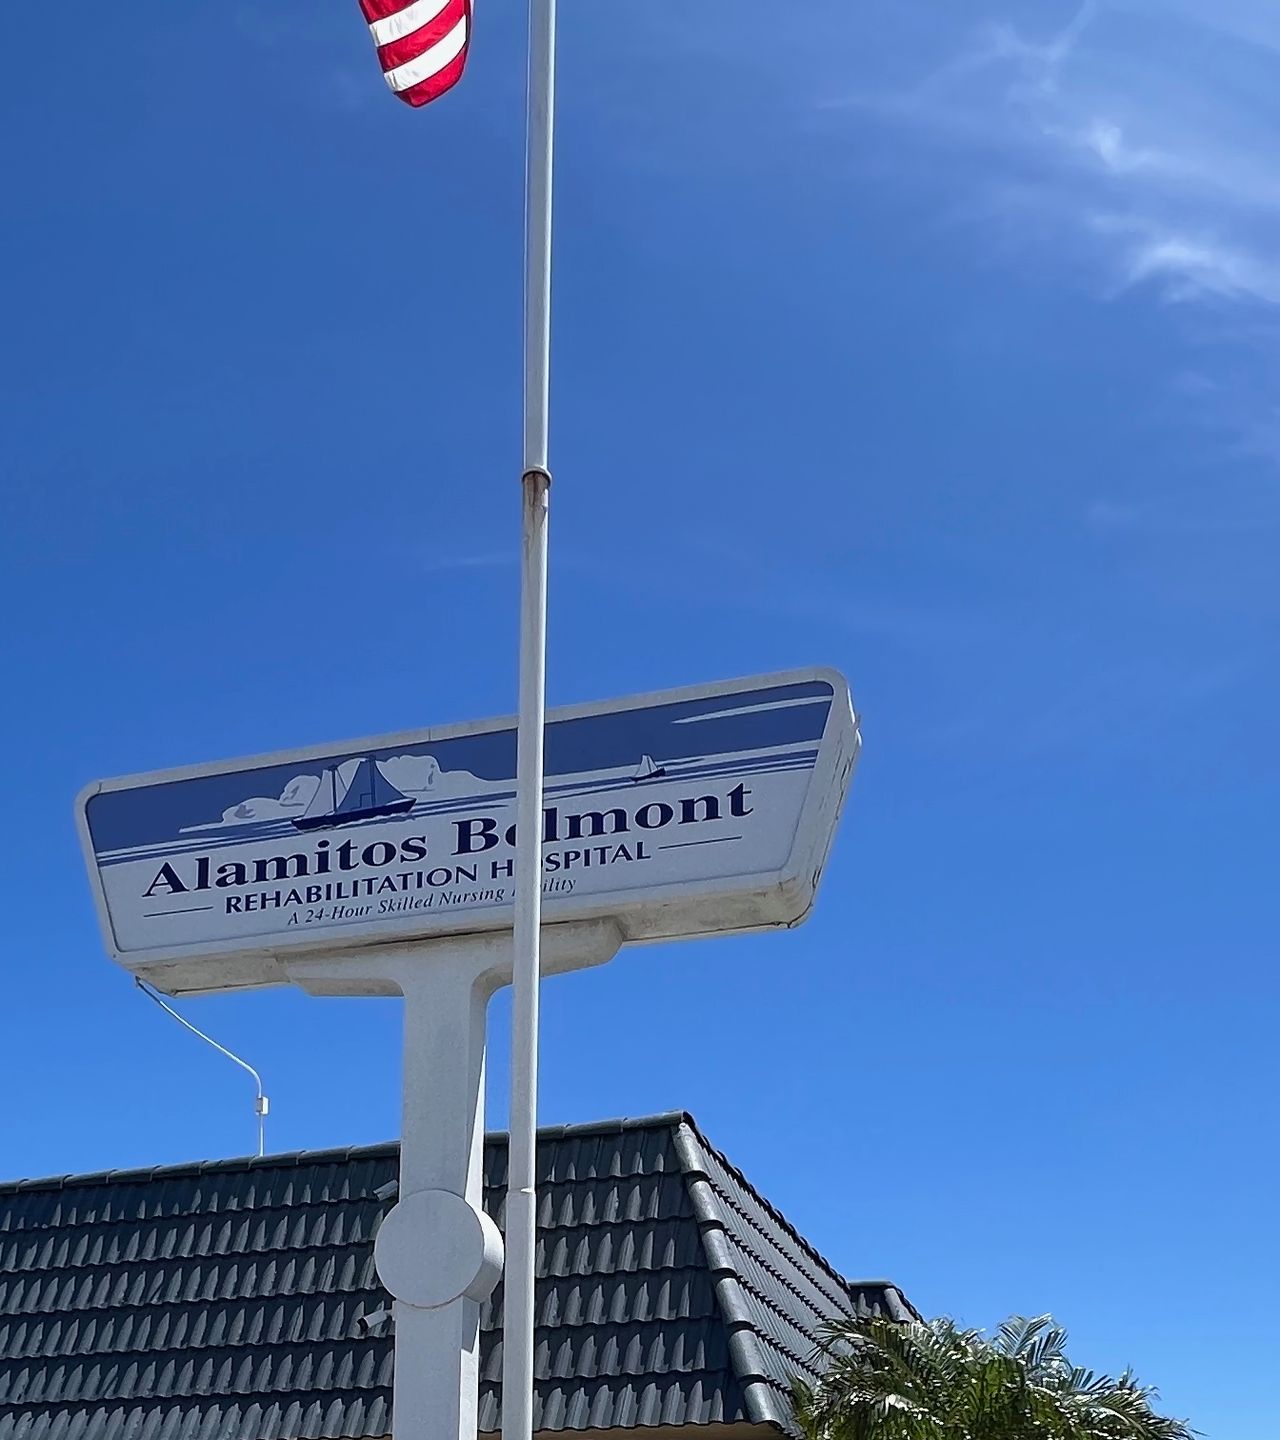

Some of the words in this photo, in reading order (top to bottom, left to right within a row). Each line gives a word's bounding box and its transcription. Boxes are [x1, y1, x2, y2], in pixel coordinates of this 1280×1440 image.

[142, 836, 427, 897] Alamitos
[225, 864, 478, 914] REHABILITATION
[491, 842, 651, 879] HSPITAL
[287, 911, 298, 925] A
[305, 905, 372, 923] 24-Hour
[377, 893, 434, 914] Skilled
[439, 887, 504, 907] Nursing
